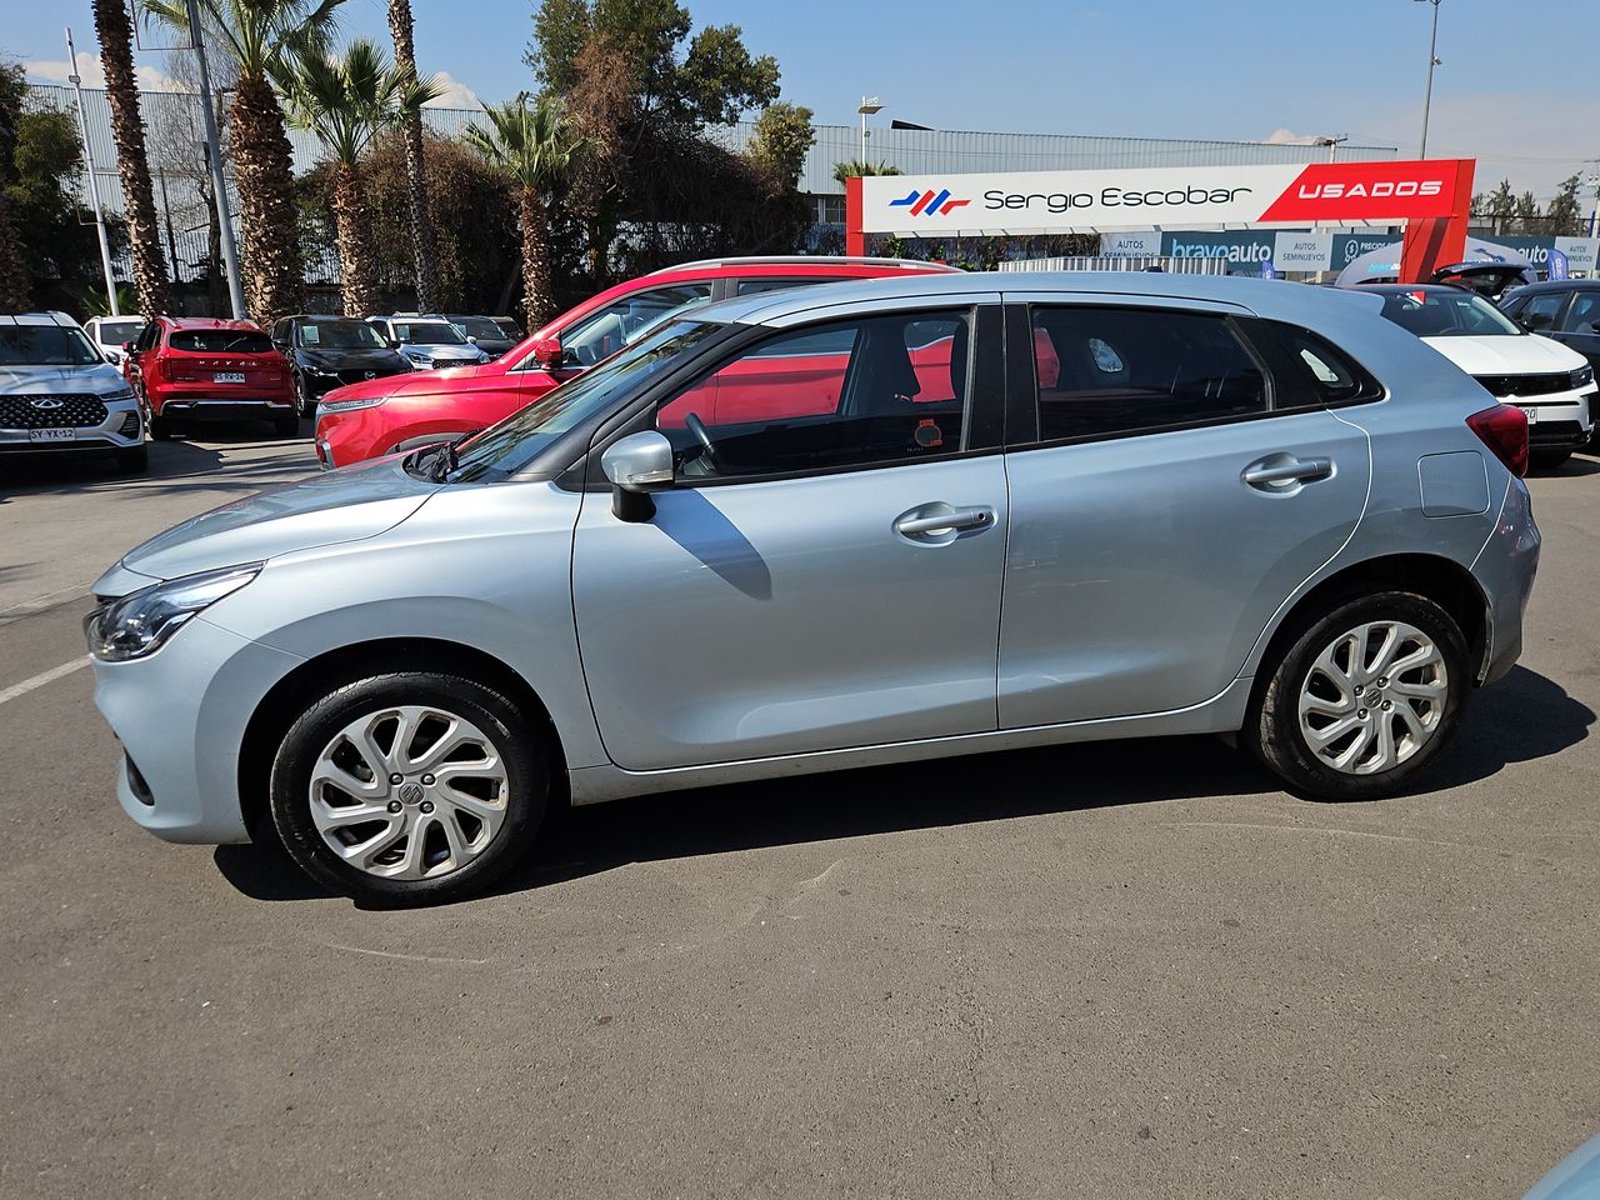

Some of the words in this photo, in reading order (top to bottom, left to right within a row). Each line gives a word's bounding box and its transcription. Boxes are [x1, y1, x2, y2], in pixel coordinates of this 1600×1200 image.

[1298, 180, 1443, 199] USADOS
[984, 190, 1094, 213] Sergio
[1101, 185, 1252, 207] Escobar
[1117, 240, 1144, 249] AUTOS
[1172, 239, 1272, 263] bravoauto
[1293, 242, 1316, 250] AUTOS
[1282, 253, 1326, 261] SEMINUEVOS
